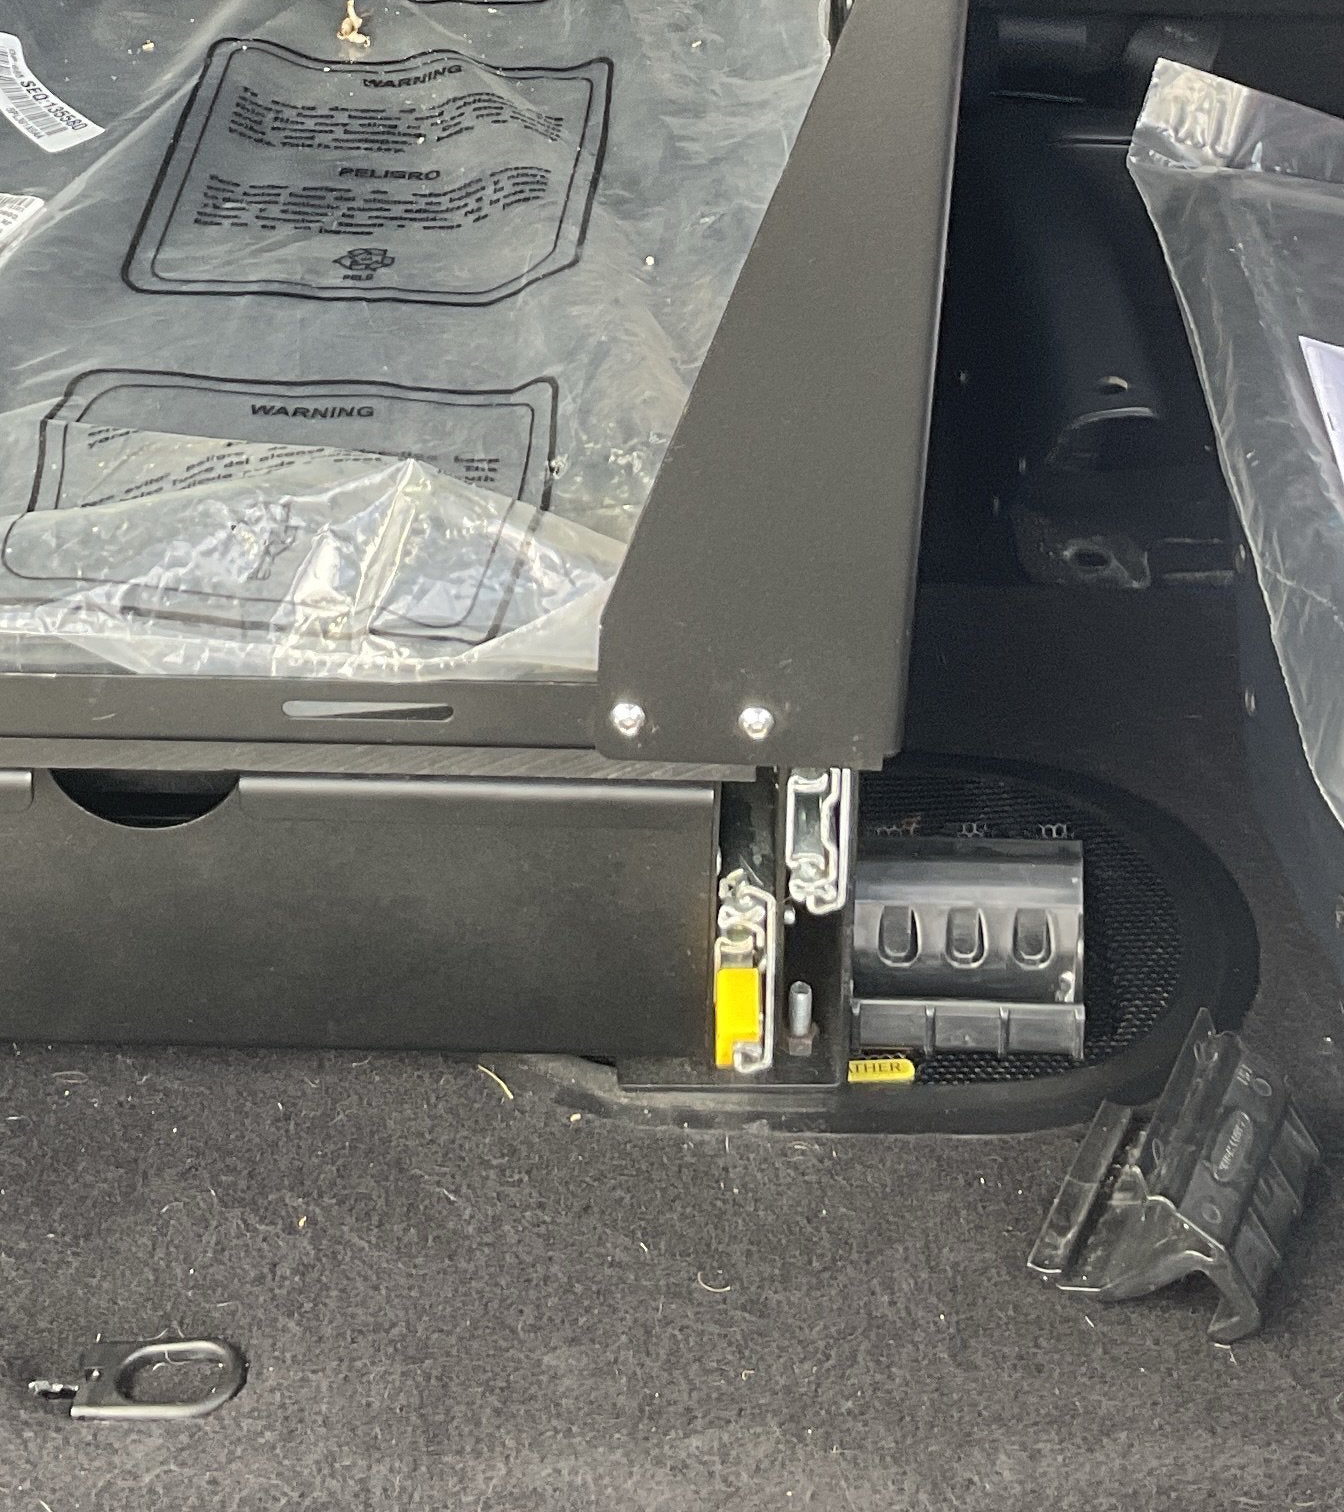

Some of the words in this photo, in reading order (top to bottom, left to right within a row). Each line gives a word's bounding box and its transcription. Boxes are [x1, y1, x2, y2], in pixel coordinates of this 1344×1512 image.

[361, 64, 463, 88] WARNING
[338, 167, 441, 182] PELIGRO
[250, 403, 375, 419] WARNING
